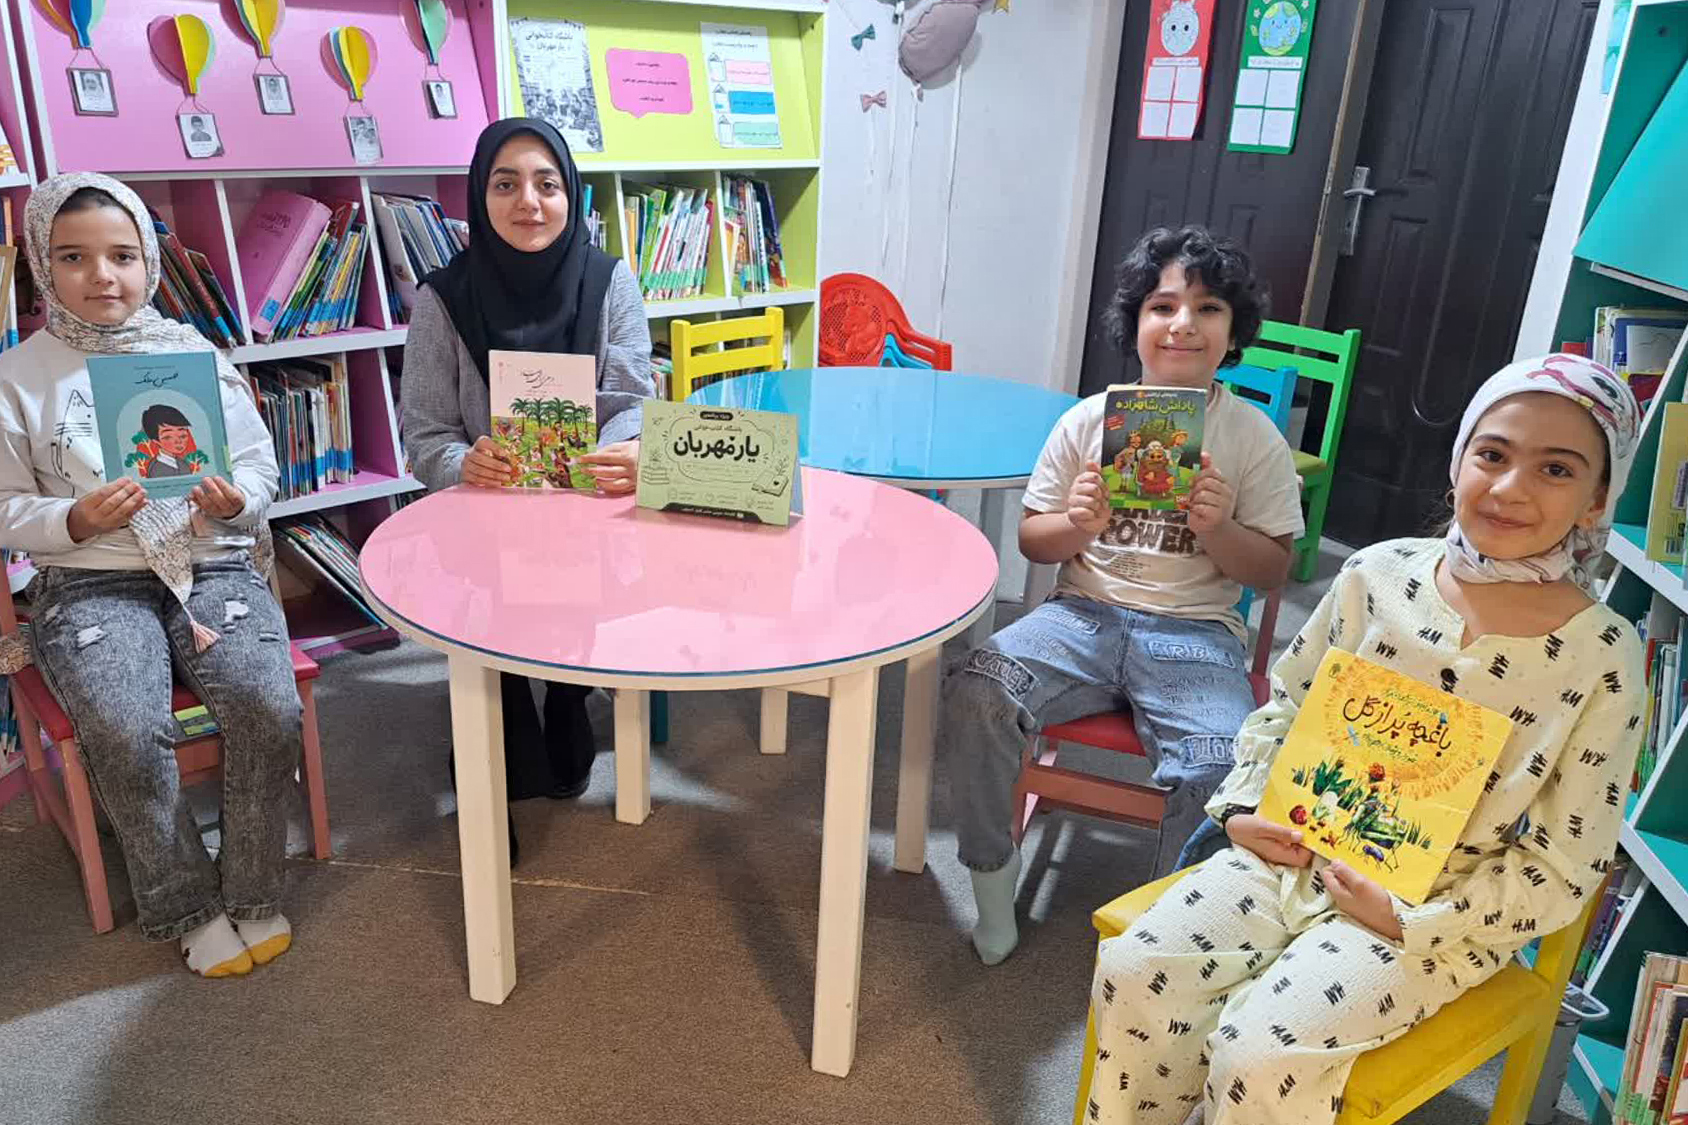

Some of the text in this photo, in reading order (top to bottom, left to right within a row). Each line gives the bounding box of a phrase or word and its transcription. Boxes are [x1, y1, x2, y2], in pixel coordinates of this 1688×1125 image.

[673, 430, 760, 463] یار مهربان
[1342, 694, 1381, 722] گل
[1363, 702, 1394, 728] از
[1407, 720, 1452, 757] باغچه
